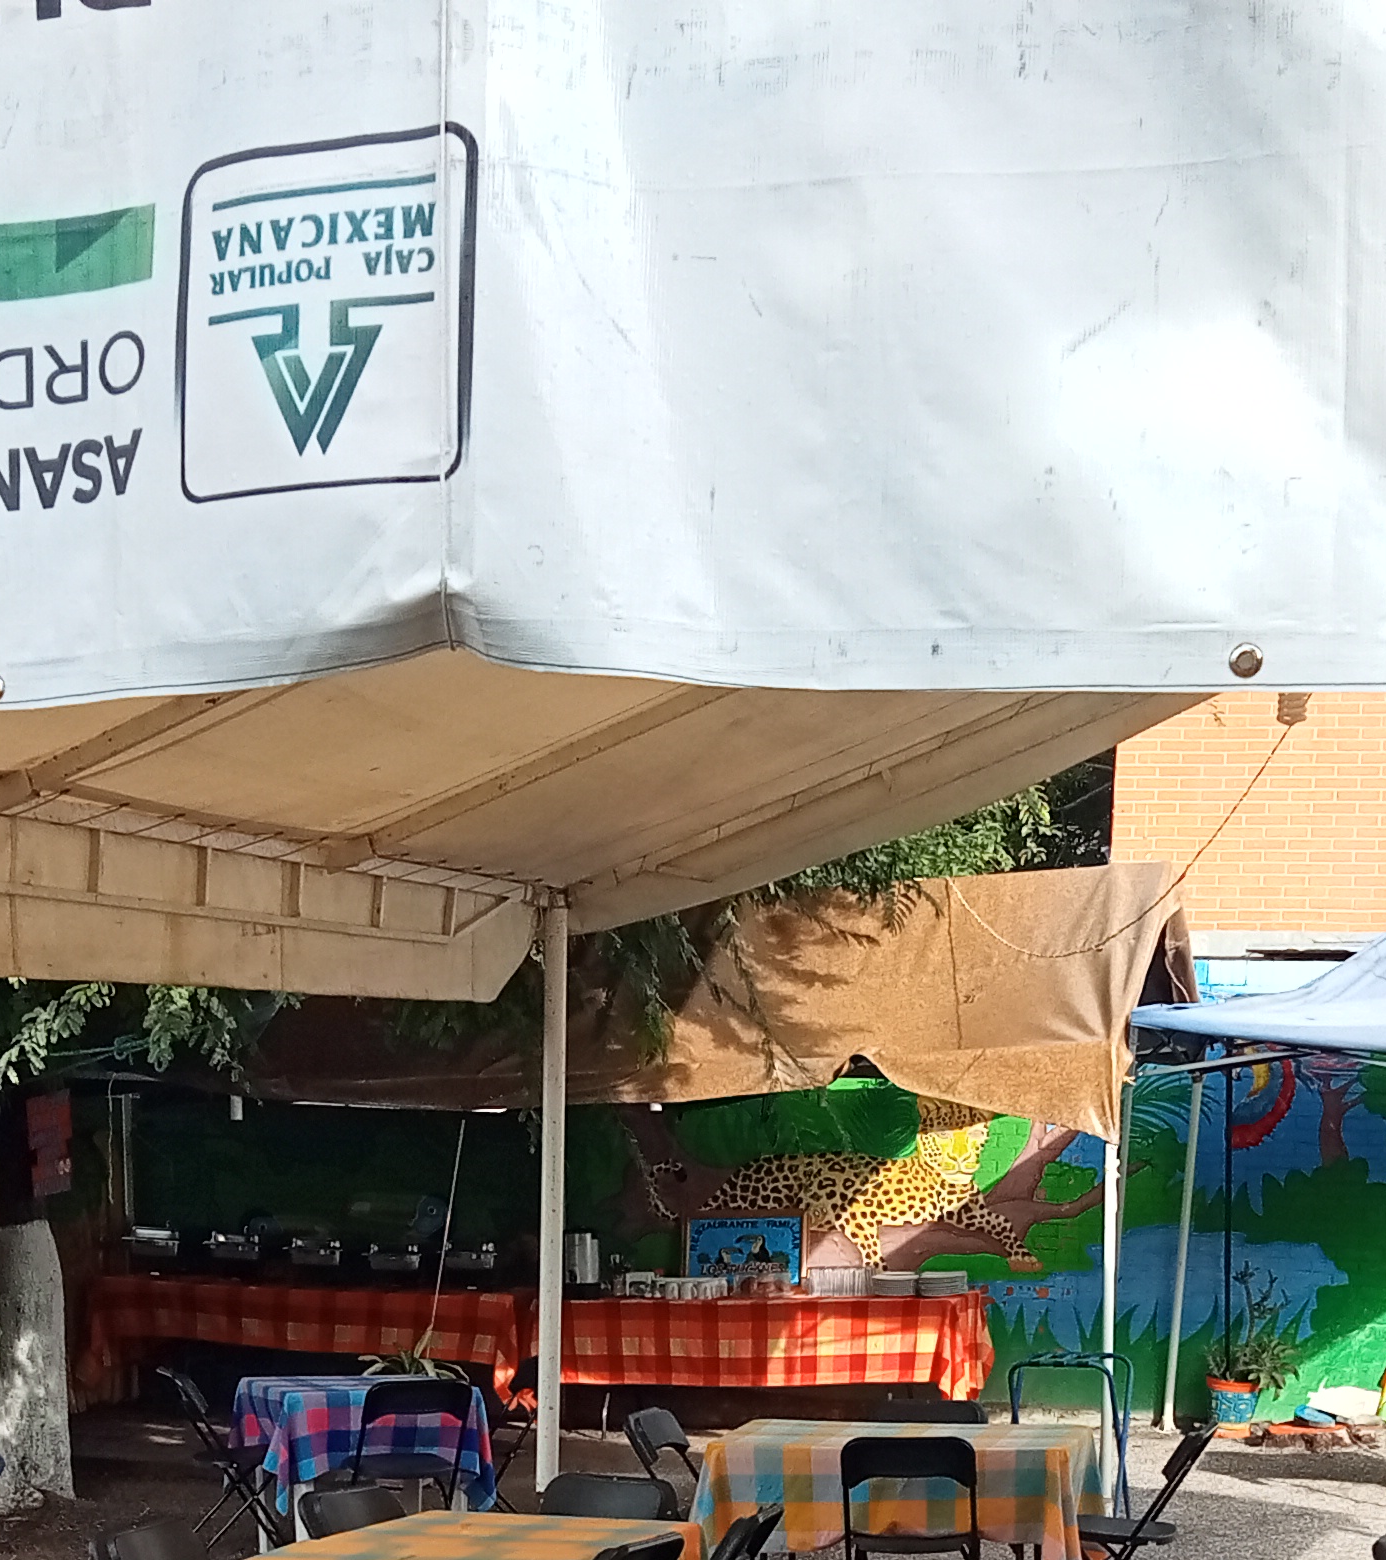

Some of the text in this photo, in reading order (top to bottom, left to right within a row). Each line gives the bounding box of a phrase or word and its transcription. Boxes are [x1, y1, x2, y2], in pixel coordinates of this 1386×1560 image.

[211, 201, 437, 262] MEXICANA
[209, 243, 435, 296] CAJA POPULAR
